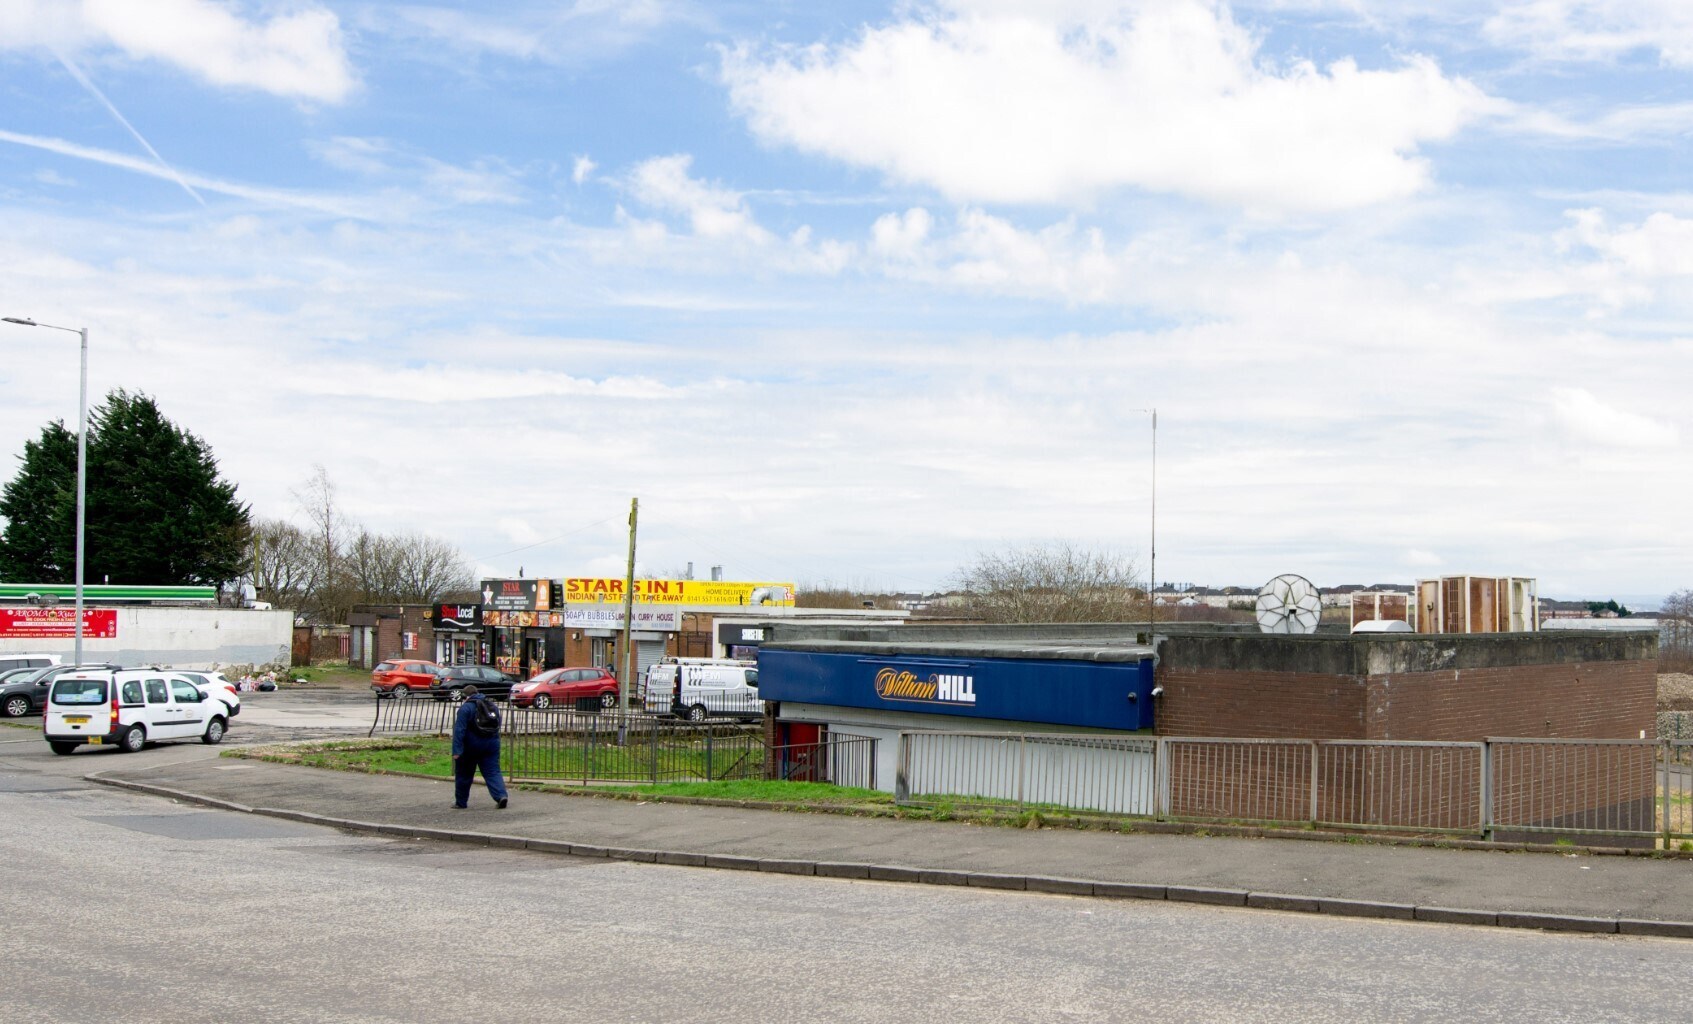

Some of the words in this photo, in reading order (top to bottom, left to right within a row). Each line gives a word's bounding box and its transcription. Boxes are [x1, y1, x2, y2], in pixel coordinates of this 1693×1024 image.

[503, 582, 520, 591] STAR
[567, 578, 623, 593] STAR
[647, 580, 669, 593] IN
[675, 581, 684, 594] 1
[662, 594, 684, 602] AWAY
[57, 610, 87, 618] Kitcn
[566, 611, 586, 620] SOAPY
[587, 611, 615, 620] BUBBLES
[638, 613, 653, 621] CURRY
[656, 613, 674, 621] HOUSE
[875, 667, 939, 700] William
[938, 674, 976, 702] HILL
